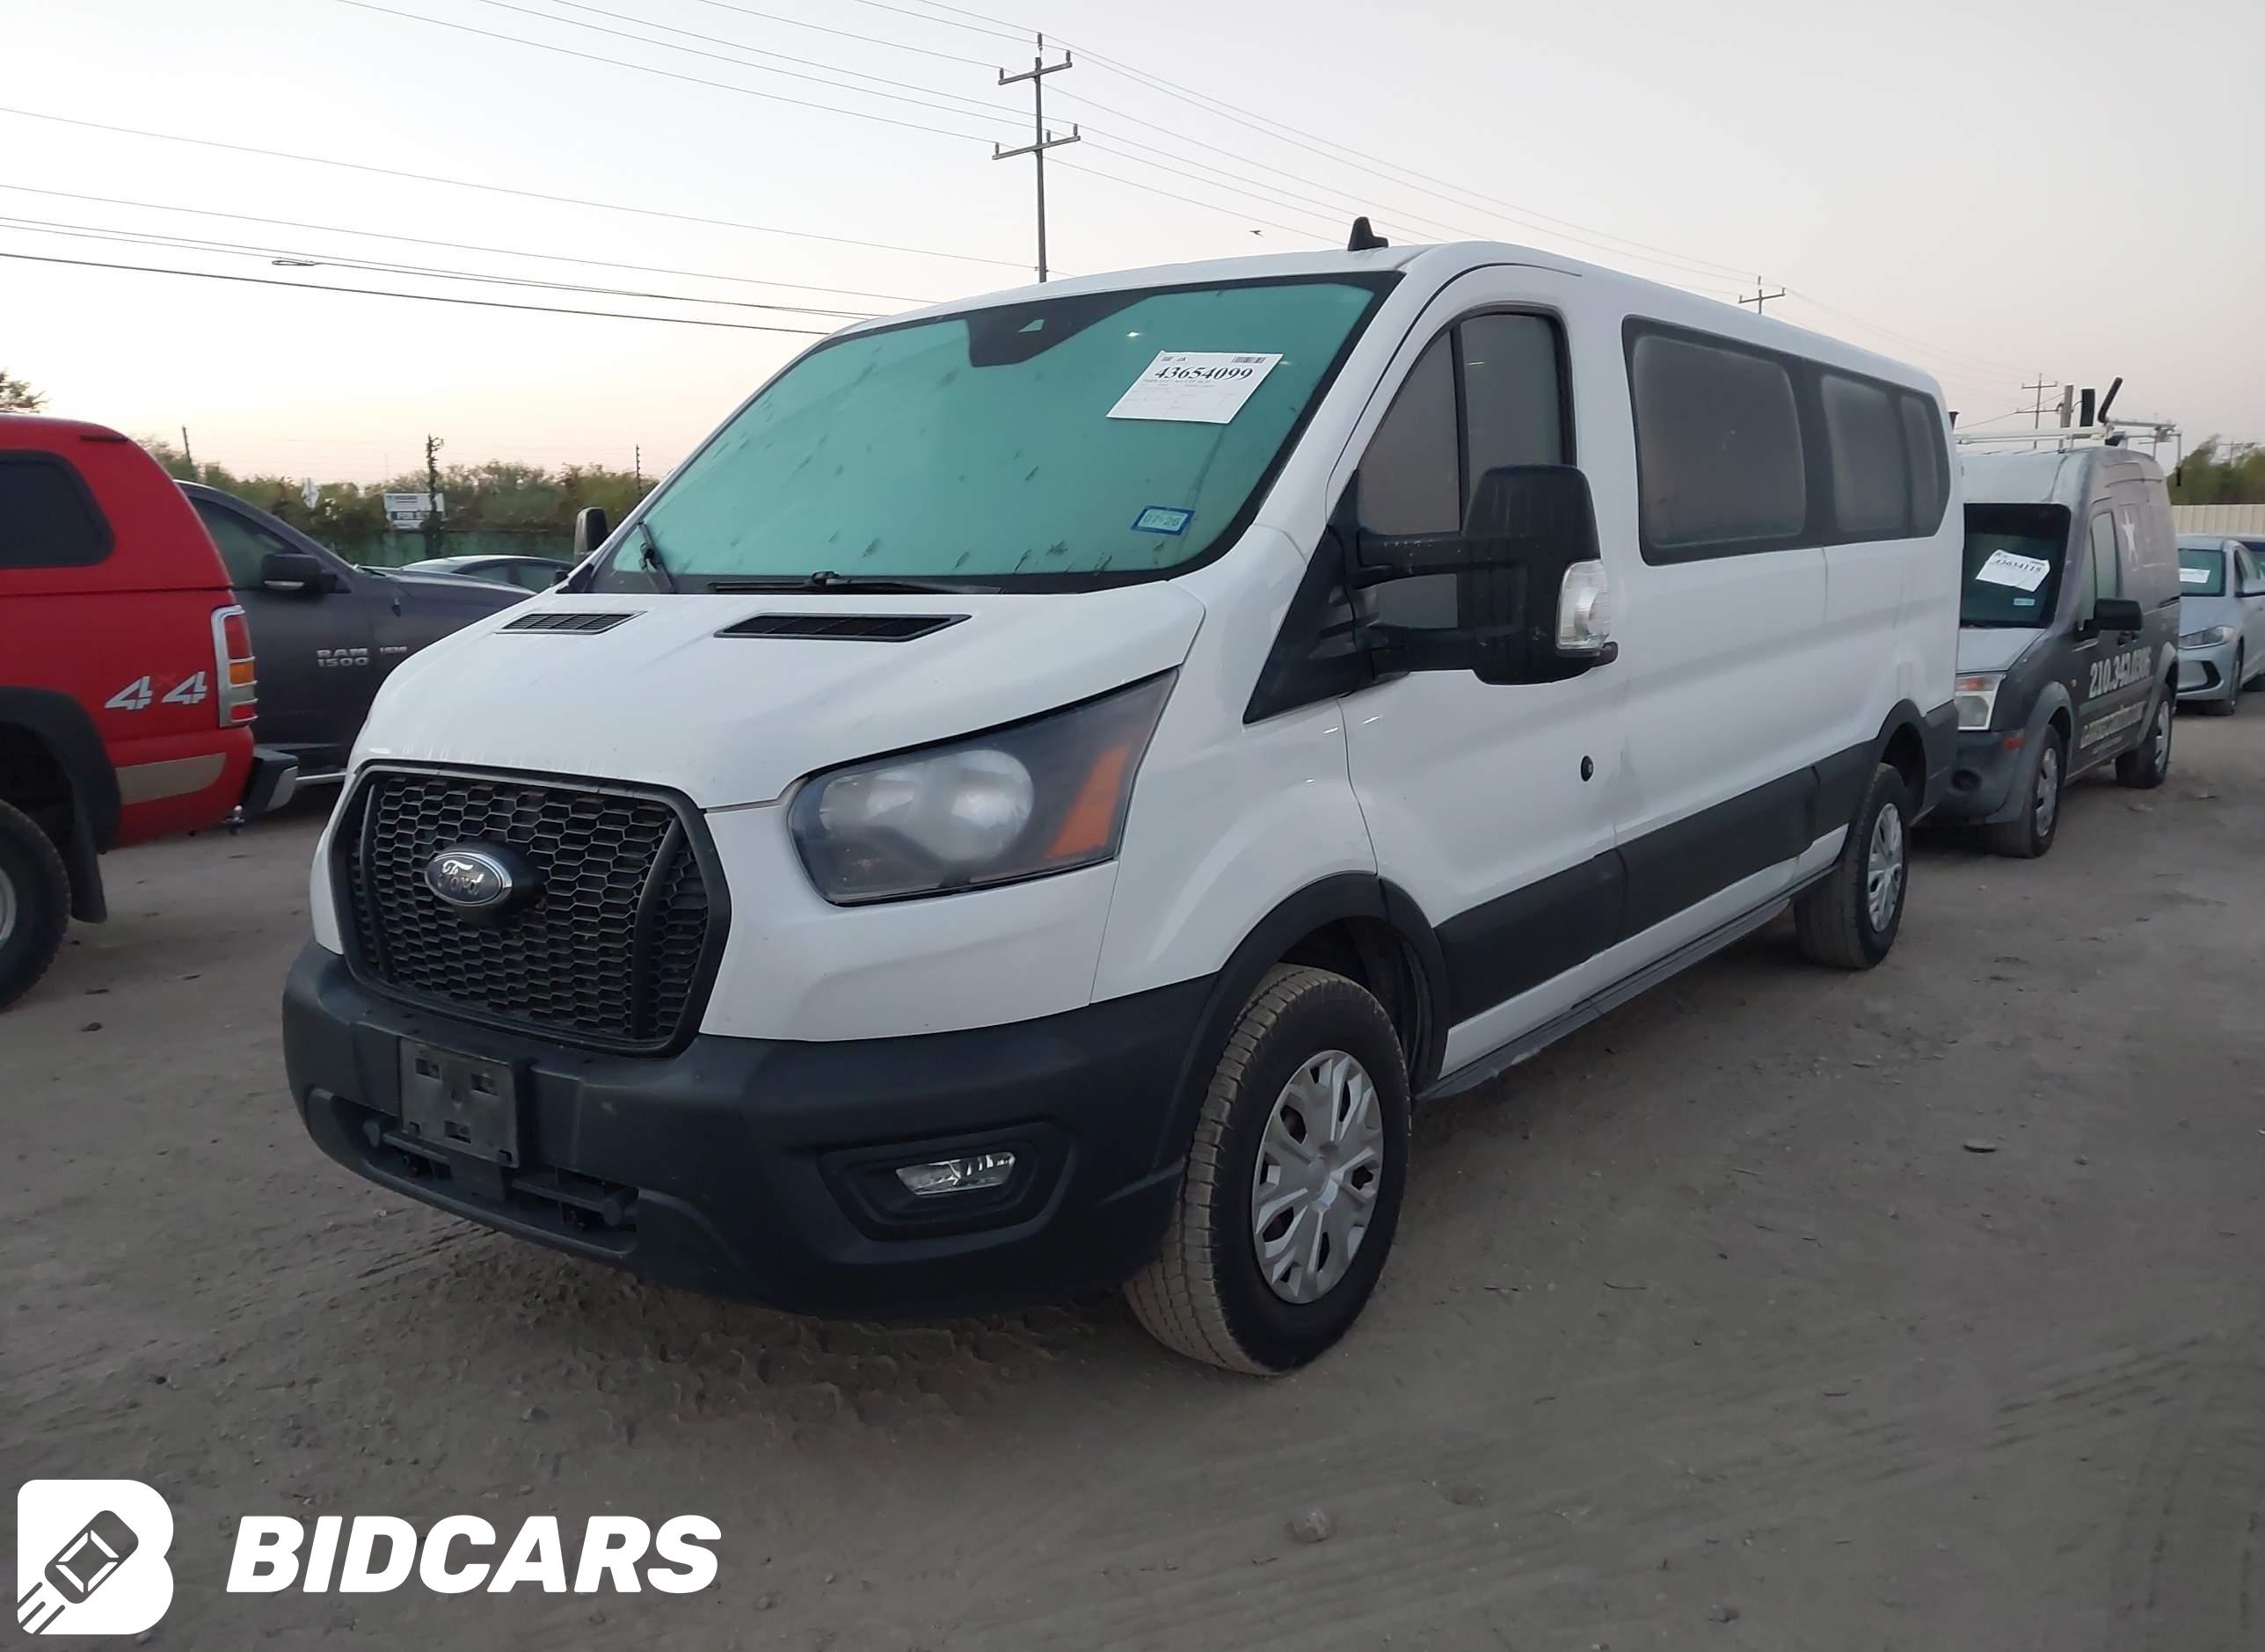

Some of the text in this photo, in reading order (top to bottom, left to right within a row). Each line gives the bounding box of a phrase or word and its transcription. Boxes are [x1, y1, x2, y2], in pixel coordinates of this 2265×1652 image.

[1154, 366, 1254, 380] 43654099
[317, 648, 368, 658] RAM
[317, 657, 368, 667] 1500
